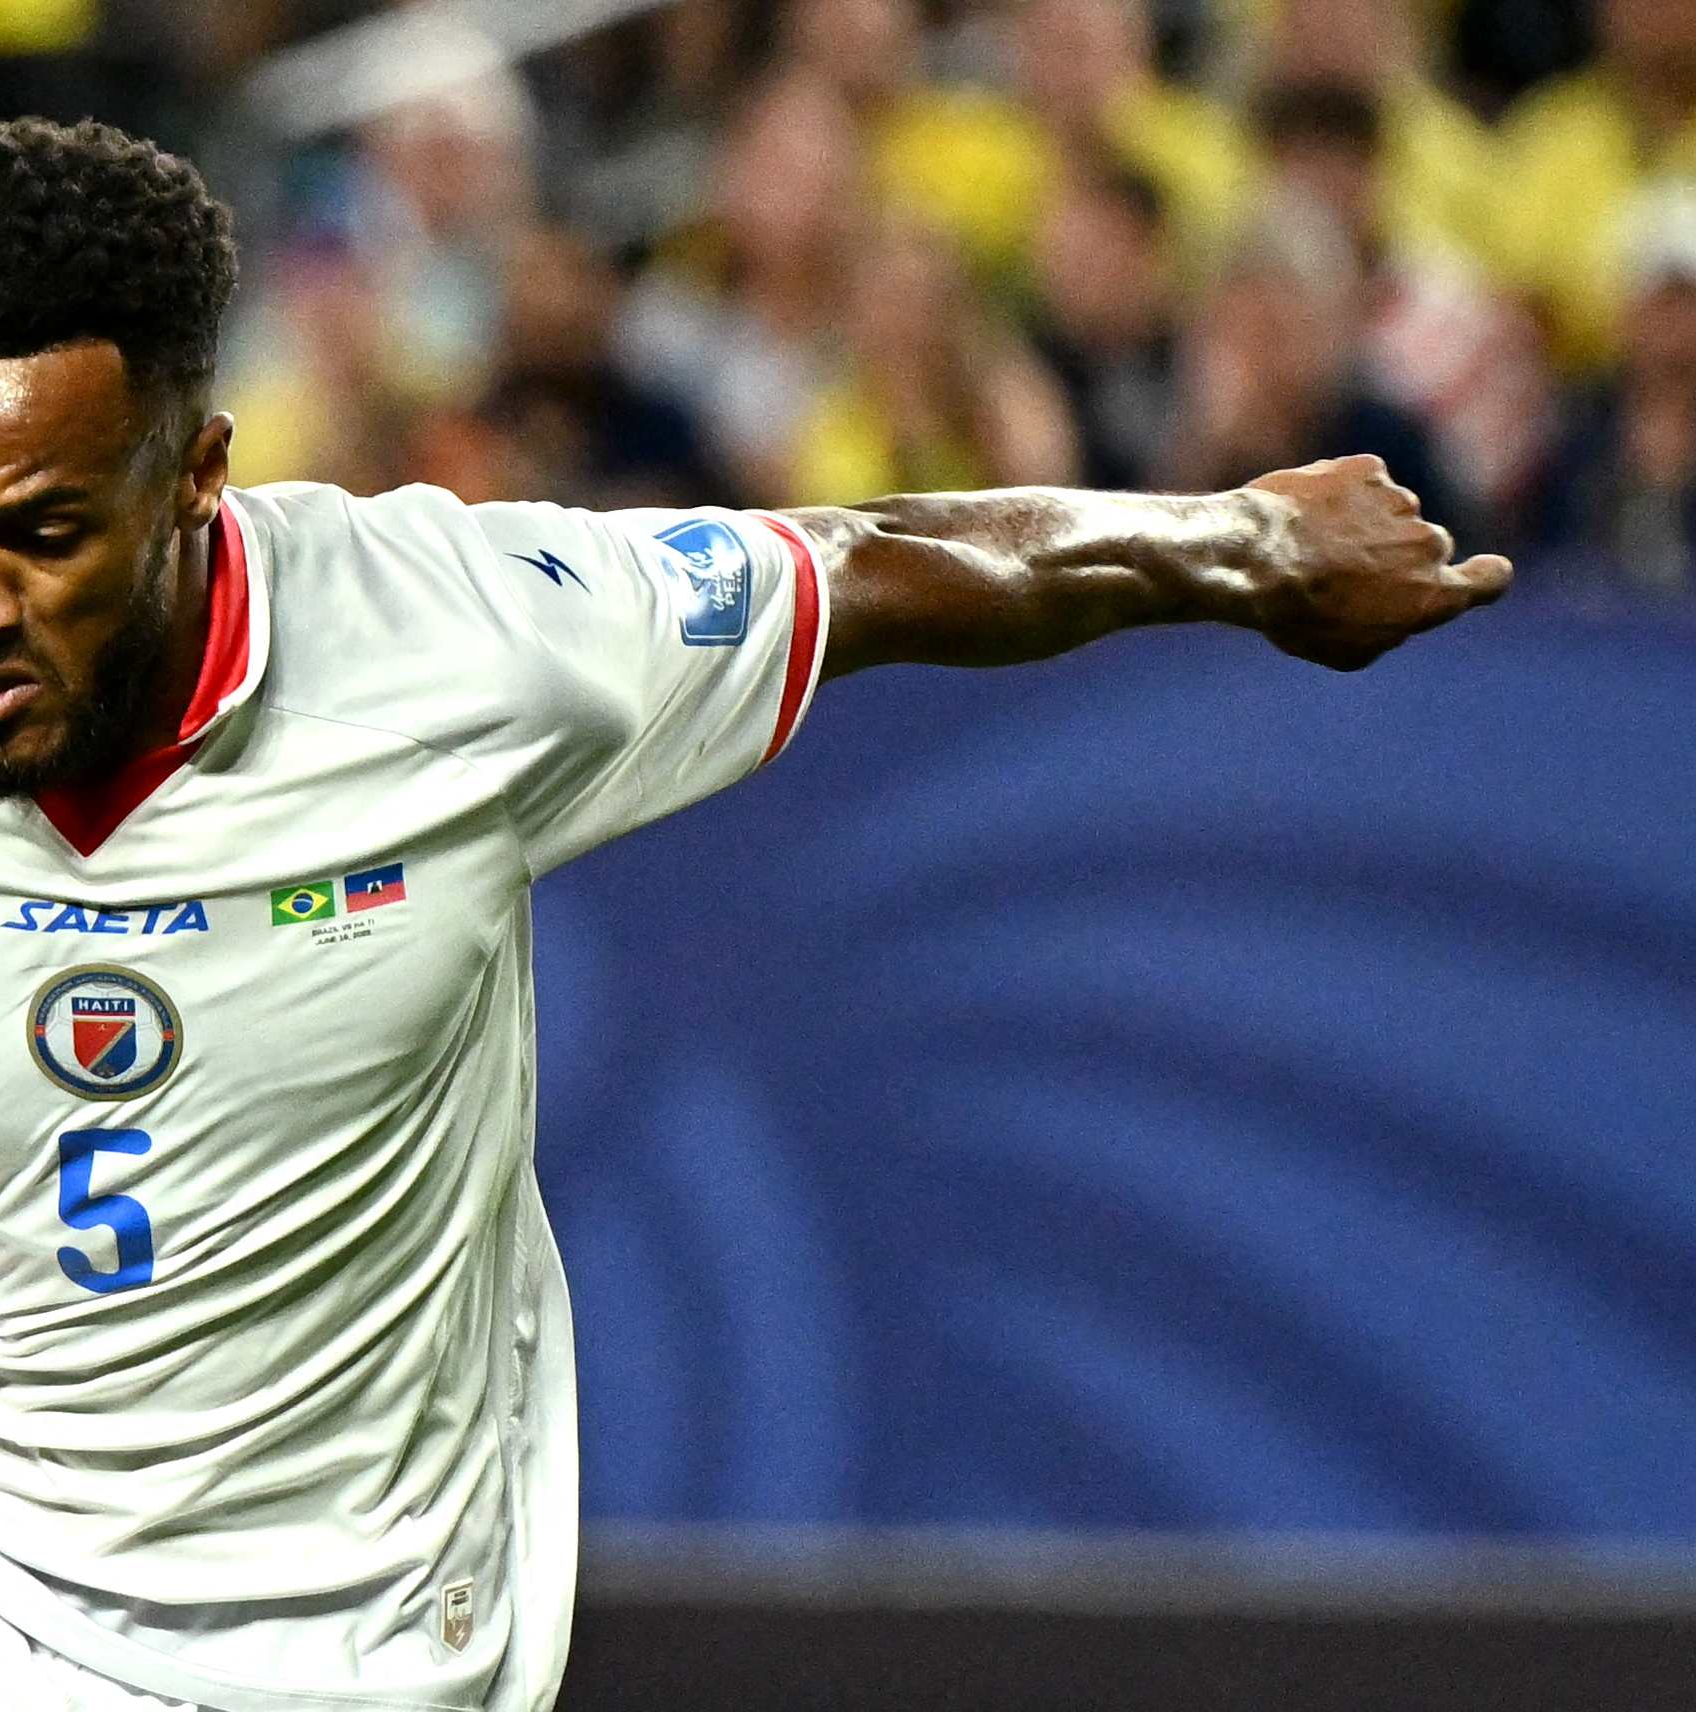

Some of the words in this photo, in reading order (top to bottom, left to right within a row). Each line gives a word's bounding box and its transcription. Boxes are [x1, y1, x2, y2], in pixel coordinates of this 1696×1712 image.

[0, 900, 209, 934] SAETA
[354, 918, 375, 929] HATI
[78, 998, 128, 1012] HAITI
[57, 1128, 153, 1294] 5
